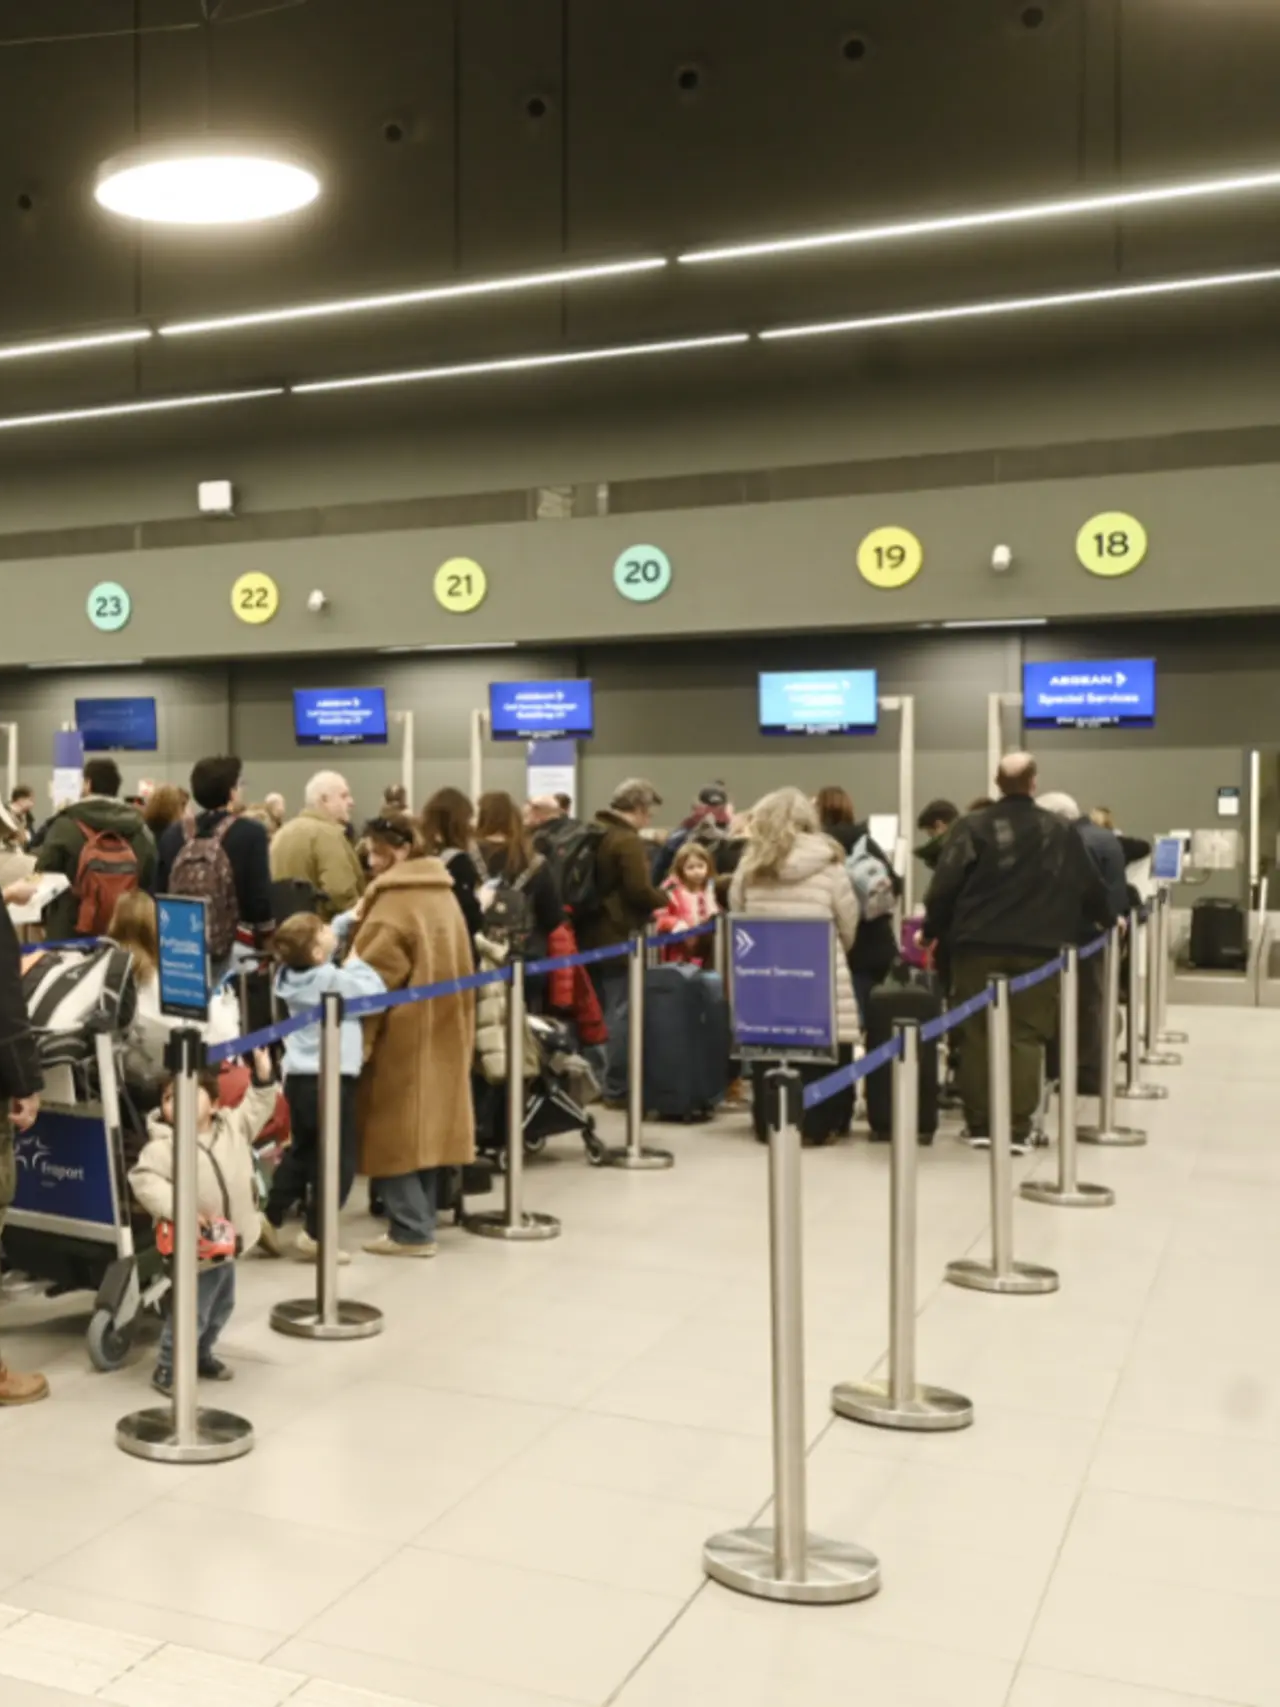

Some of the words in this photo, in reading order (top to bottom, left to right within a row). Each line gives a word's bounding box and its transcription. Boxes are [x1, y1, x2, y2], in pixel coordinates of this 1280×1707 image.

[1094, 531, 1130, 558] 18
[874, 545, 906, 569] 19
[624, 559, 661, 585] 20
[447, 574, 473, 598] 21
[96, 595, 123, 618] 23
[240, 587, 269, 610] 22
